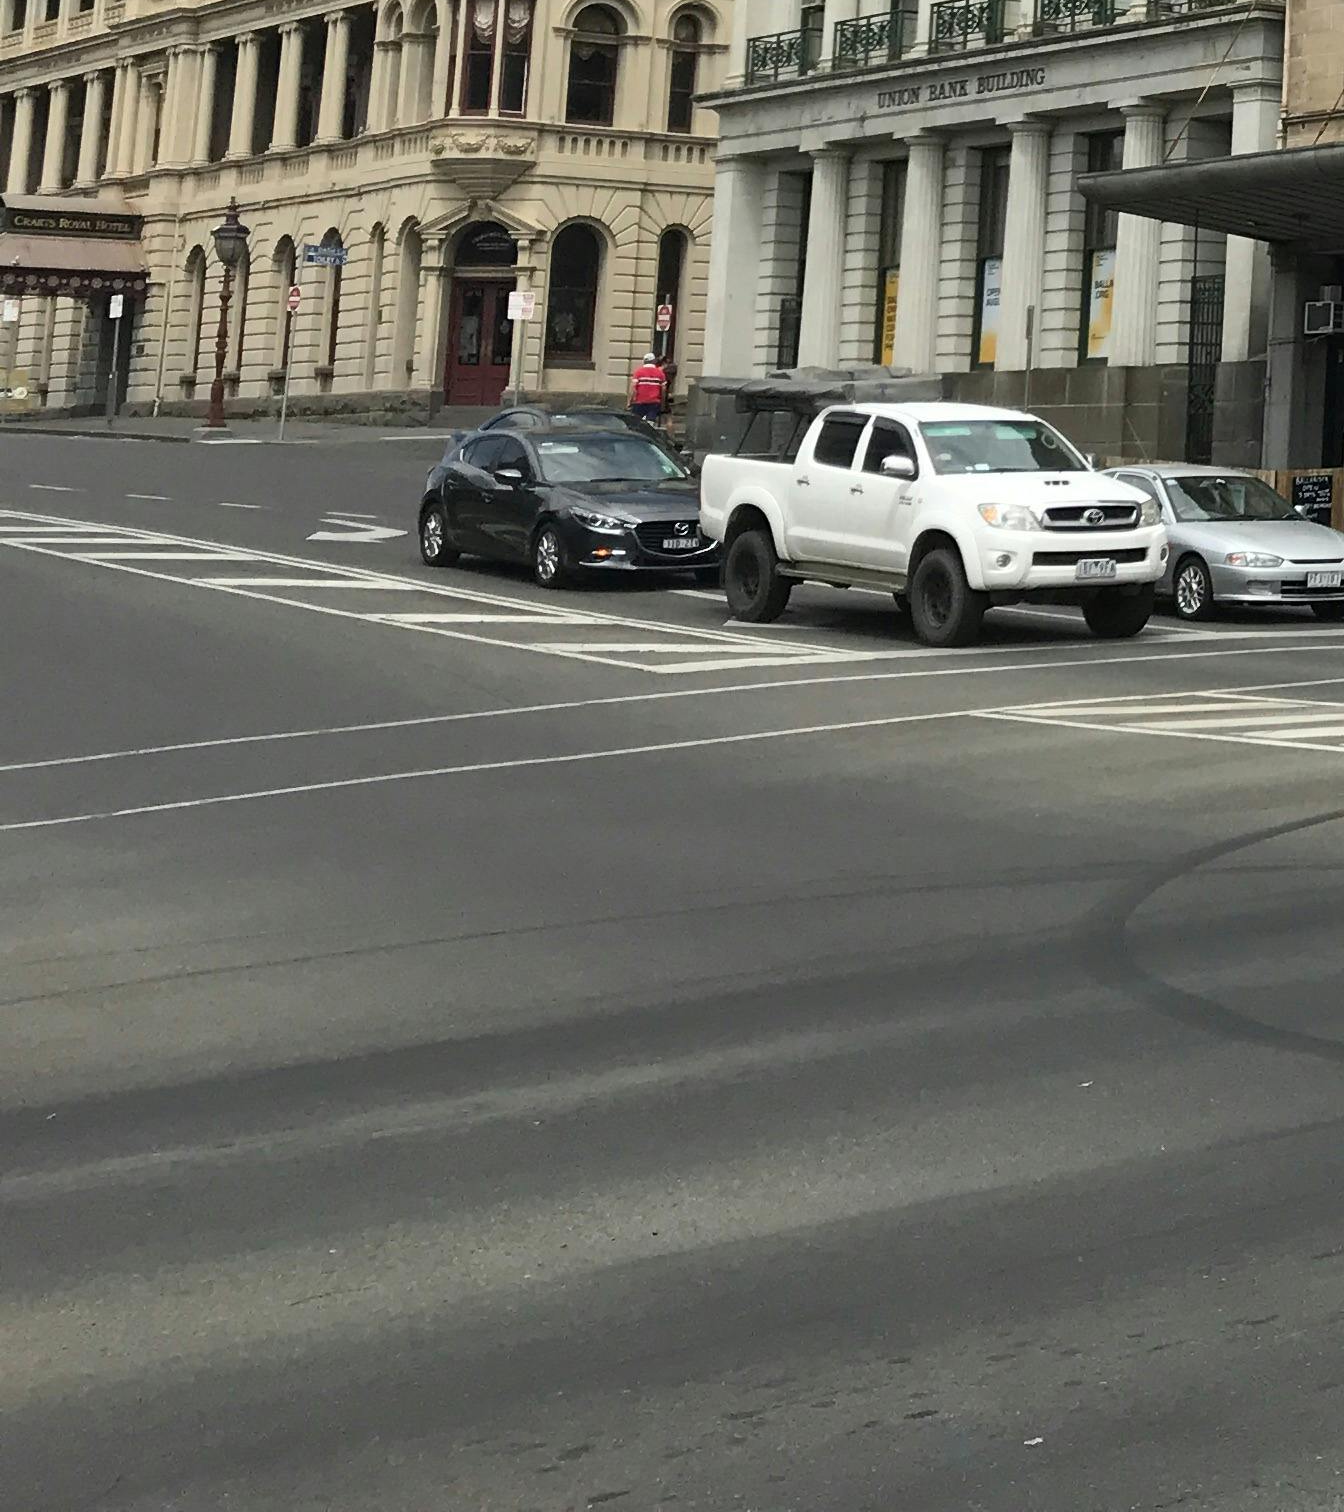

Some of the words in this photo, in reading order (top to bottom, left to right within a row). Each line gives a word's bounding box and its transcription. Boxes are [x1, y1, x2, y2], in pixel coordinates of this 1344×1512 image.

[877, 87, 921, 109] UNION
[927, 79, 969, 102] BANK
[975, 67, 1046, 94] BUILDING
[59, 218, 91, 229] ROYAL
[95, 219, 131, 232] HOTEL
